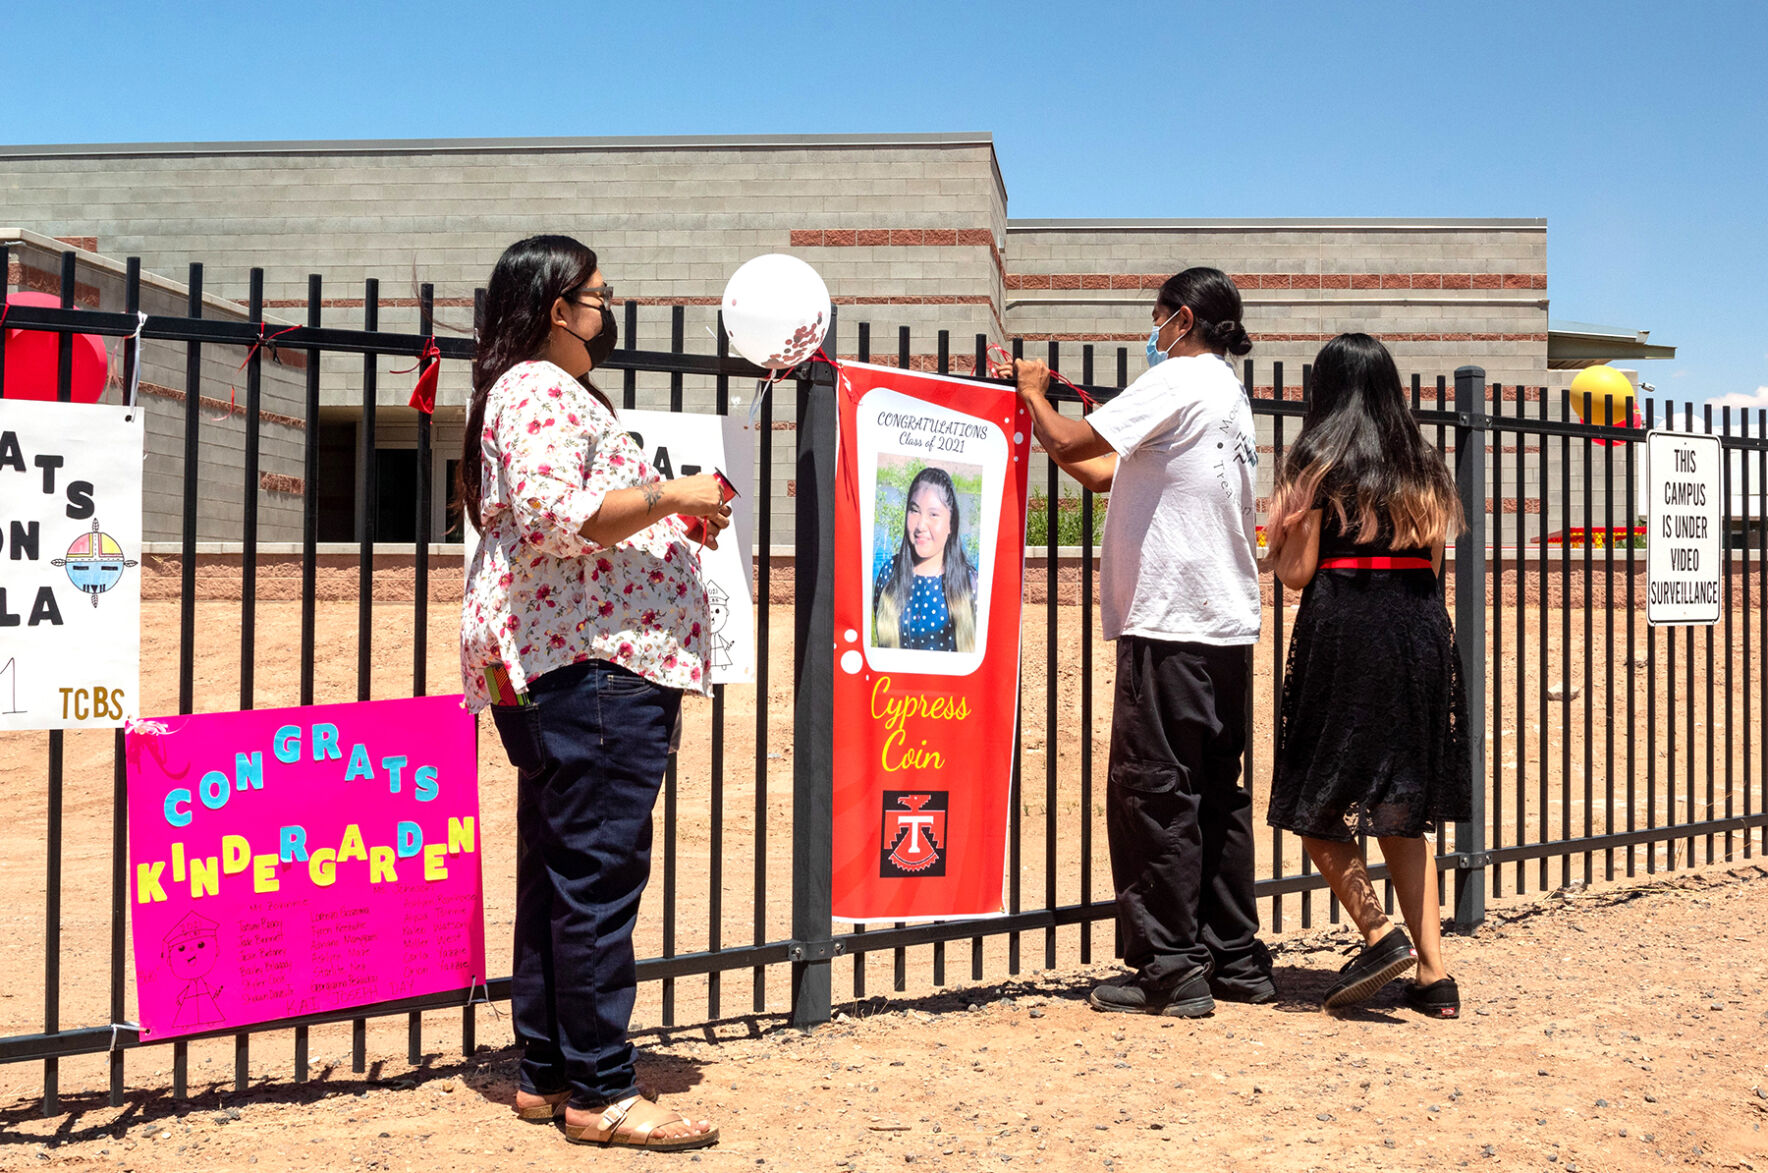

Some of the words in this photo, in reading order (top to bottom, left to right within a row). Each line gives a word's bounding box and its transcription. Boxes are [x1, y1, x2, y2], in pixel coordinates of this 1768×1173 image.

[877, 411, 988, 440] CONGRATULATIONS
[899, 431, 922, 447] Class
[925, 435, 936, 452] of
[937, 436, 965, 453] 2021
[1674, 449, 1697, 473] THIS
[1664, 481, 1706, 506] CAMPUS
[0, 520, 39, 560] N
[1662, 514, 1672, 539] IS
[1675, 515, 1708, 539] UNDER
[1670, 548, 1700, 572] VIDEO
[1651, 581, 1718, 605] SURVEILLANCE
[59, 686, 125, 720] TCBS
[871, 676, 972, 730] Cypress
[881, 729, 945, 772] Coin
[164, 723, 439, 827] CONGRATS
[898, 816, 934, 853] T
[137, 816, 475, 903] KINDERGARDEN
